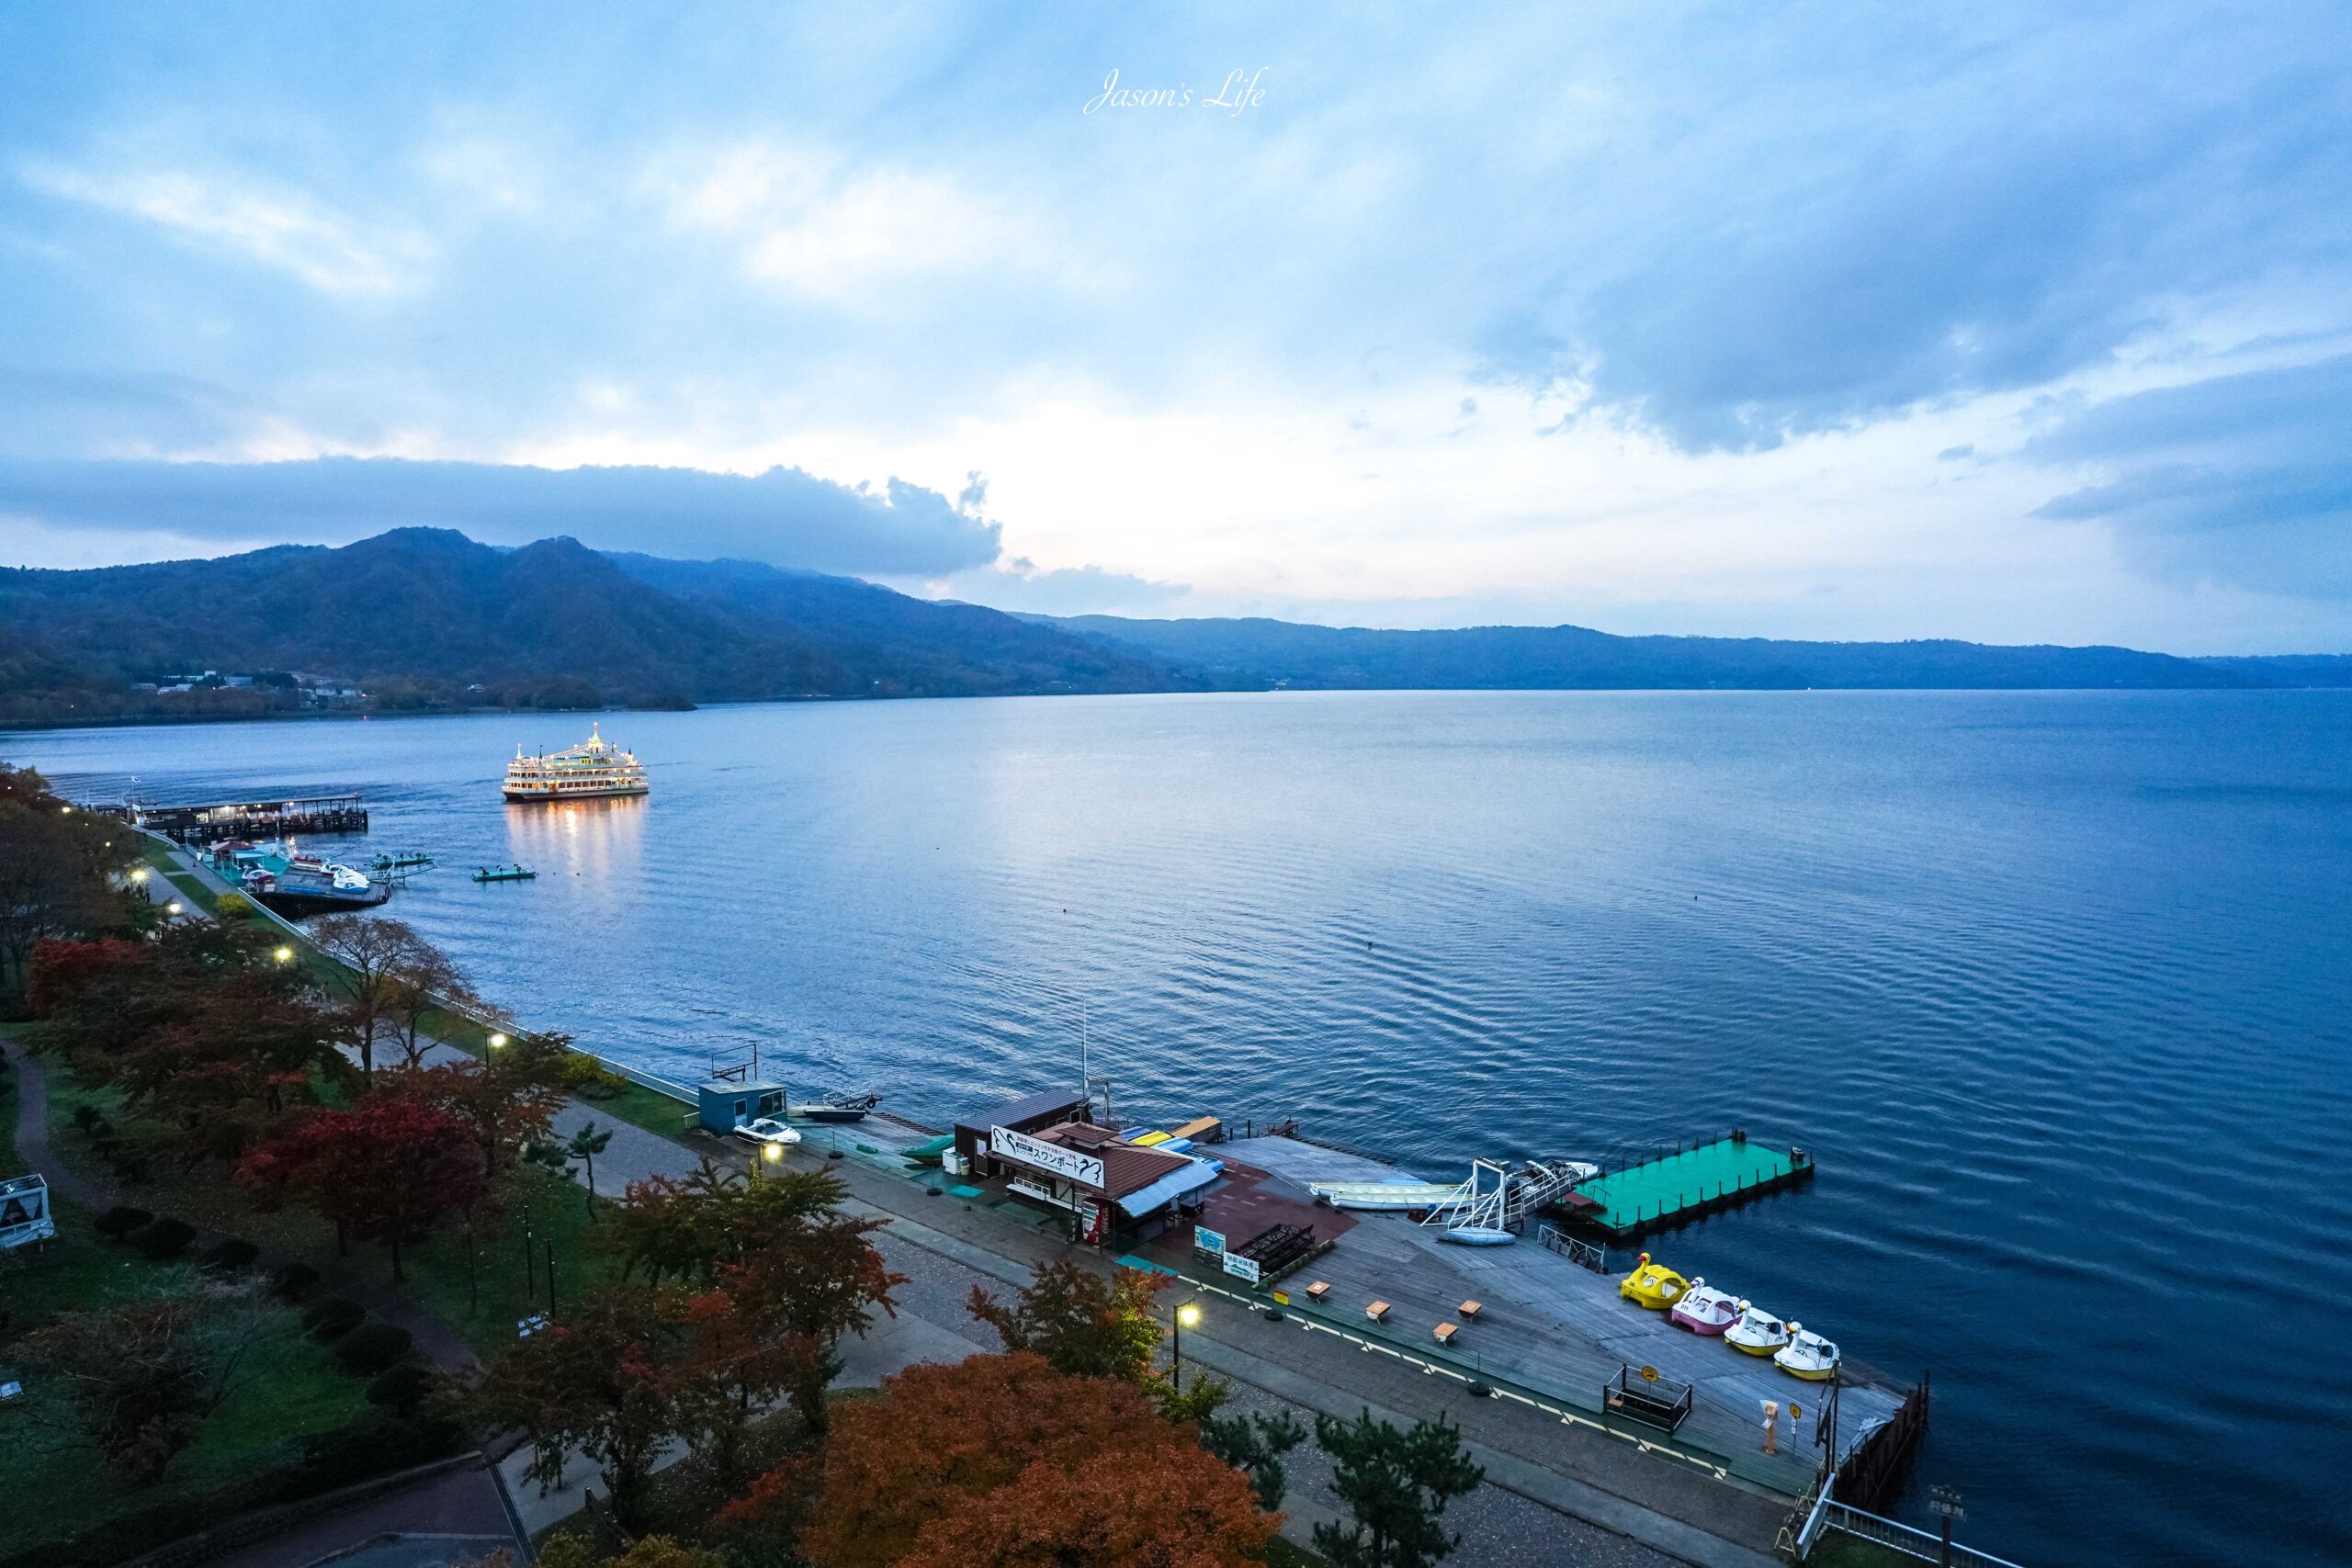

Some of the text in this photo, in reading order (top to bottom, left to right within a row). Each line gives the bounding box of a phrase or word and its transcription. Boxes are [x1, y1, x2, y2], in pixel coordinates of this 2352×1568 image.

[1034, 1148, 1080, 1171] スワンボート
